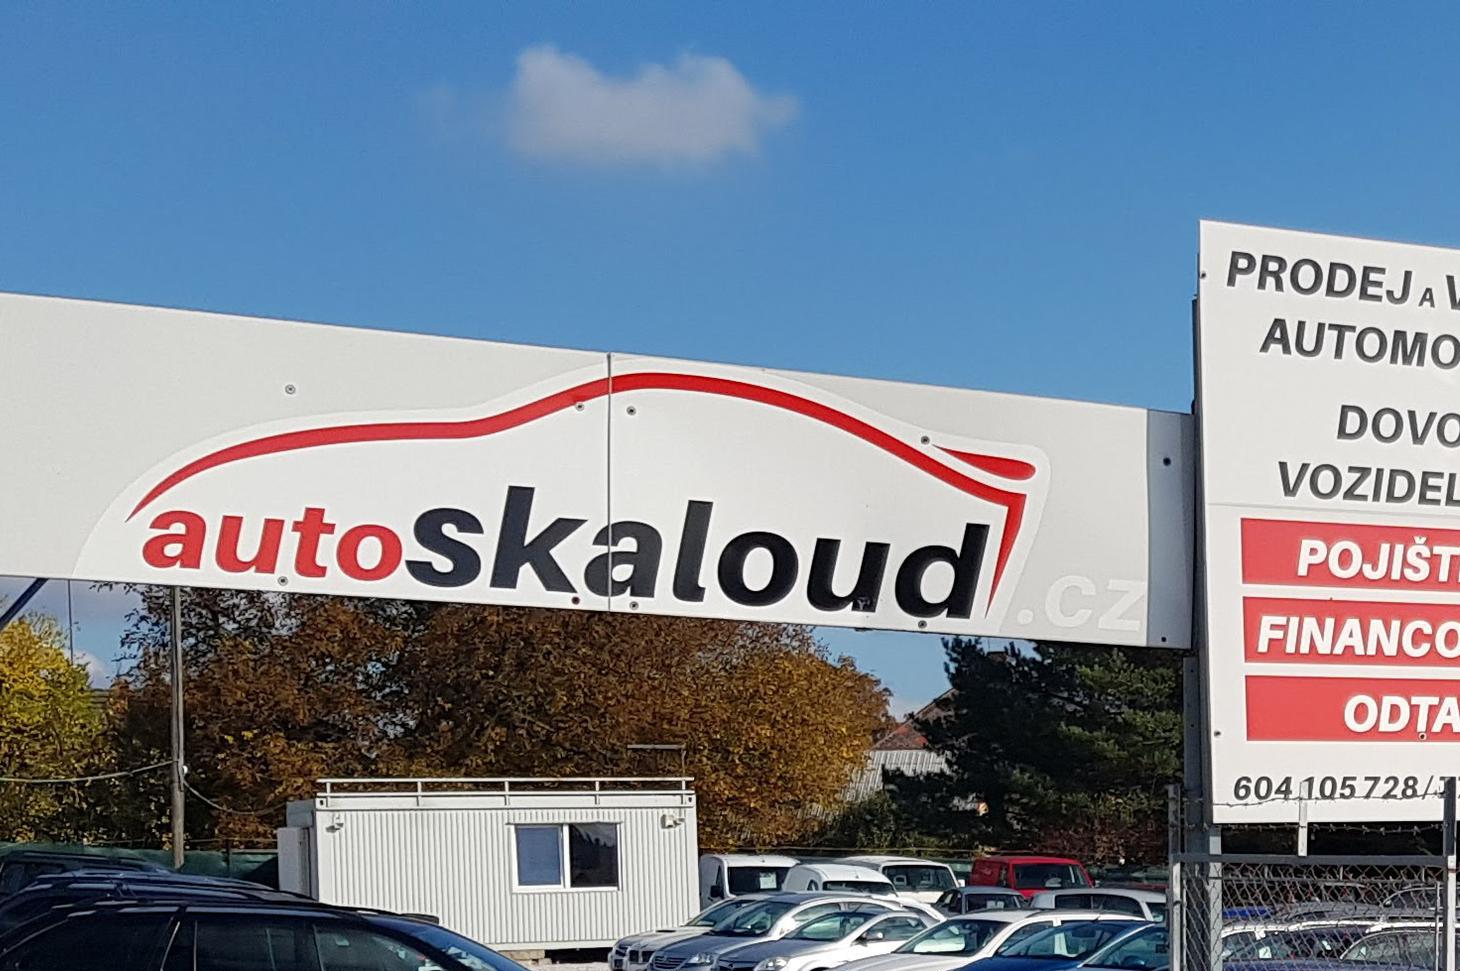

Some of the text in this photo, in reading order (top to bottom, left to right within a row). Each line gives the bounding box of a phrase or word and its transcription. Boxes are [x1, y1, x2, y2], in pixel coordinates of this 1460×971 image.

[1226, 251, 1413, 305] PRODEJ
[1233, 776, 1293, 800] 604
[1301, 776, 1357, 799] 105
